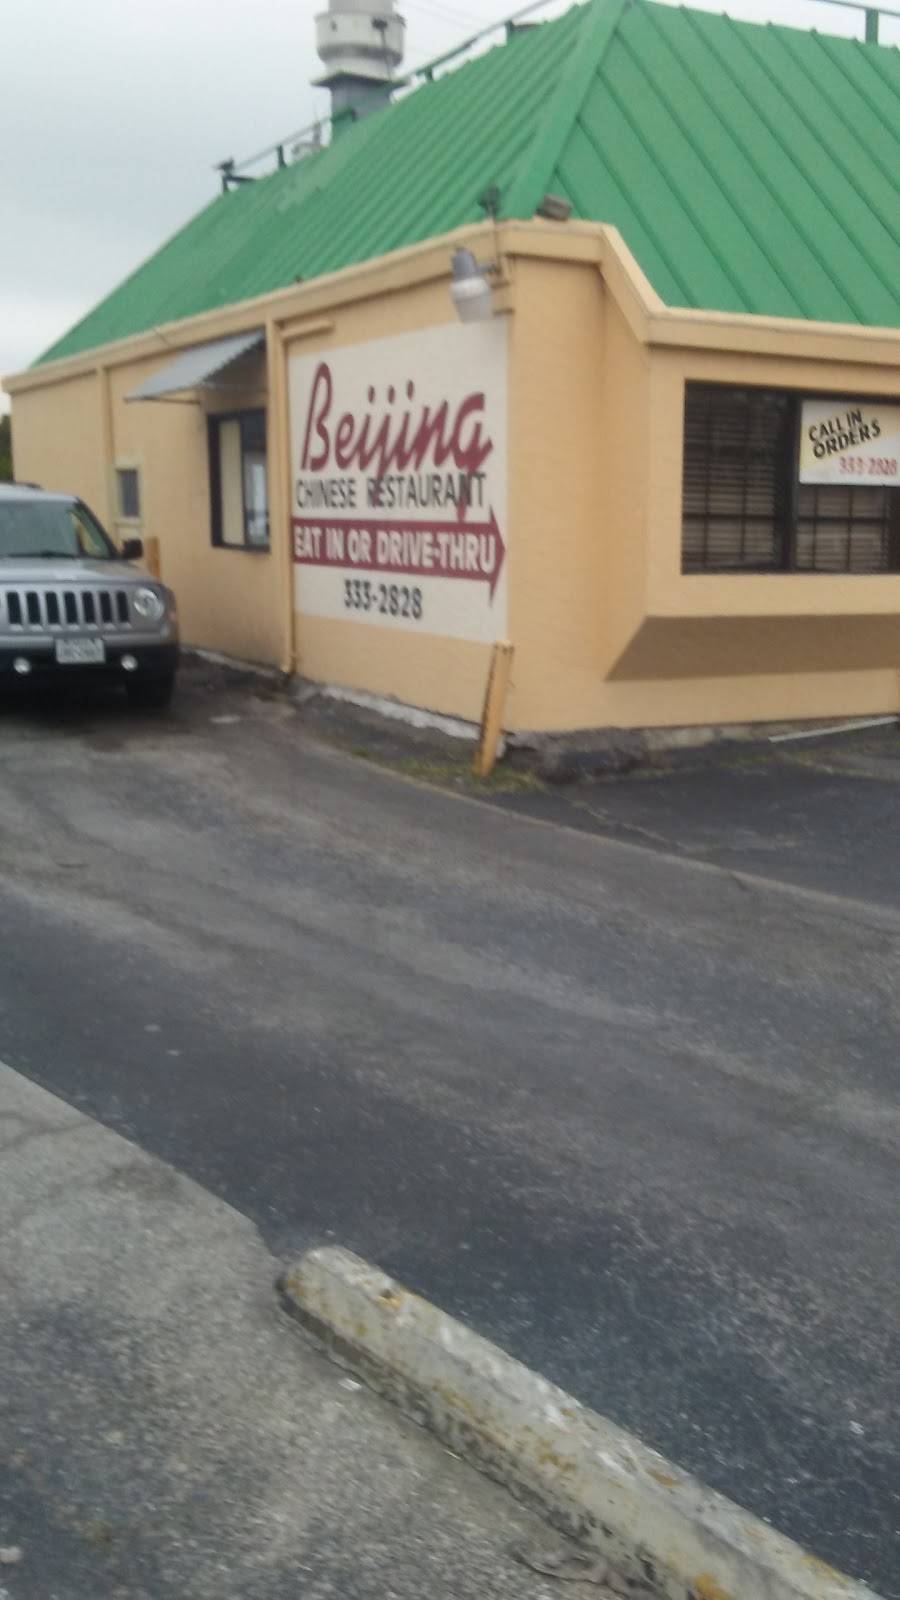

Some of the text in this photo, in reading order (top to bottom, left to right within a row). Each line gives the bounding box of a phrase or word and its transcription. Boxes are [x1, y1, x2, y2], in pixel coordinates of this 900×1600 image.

[301, 361, 494, 521] Beijing
[808, 409, 863, 442] CALL IN
[813, 419, 881, 459] ORDERS
[296, 473, 486, 508] CHINESE RESTAURANT
[294, 526, 496, 573] EAT IN OR DRIVE-THRU
[344, 579, 423, 619] 333-2828
